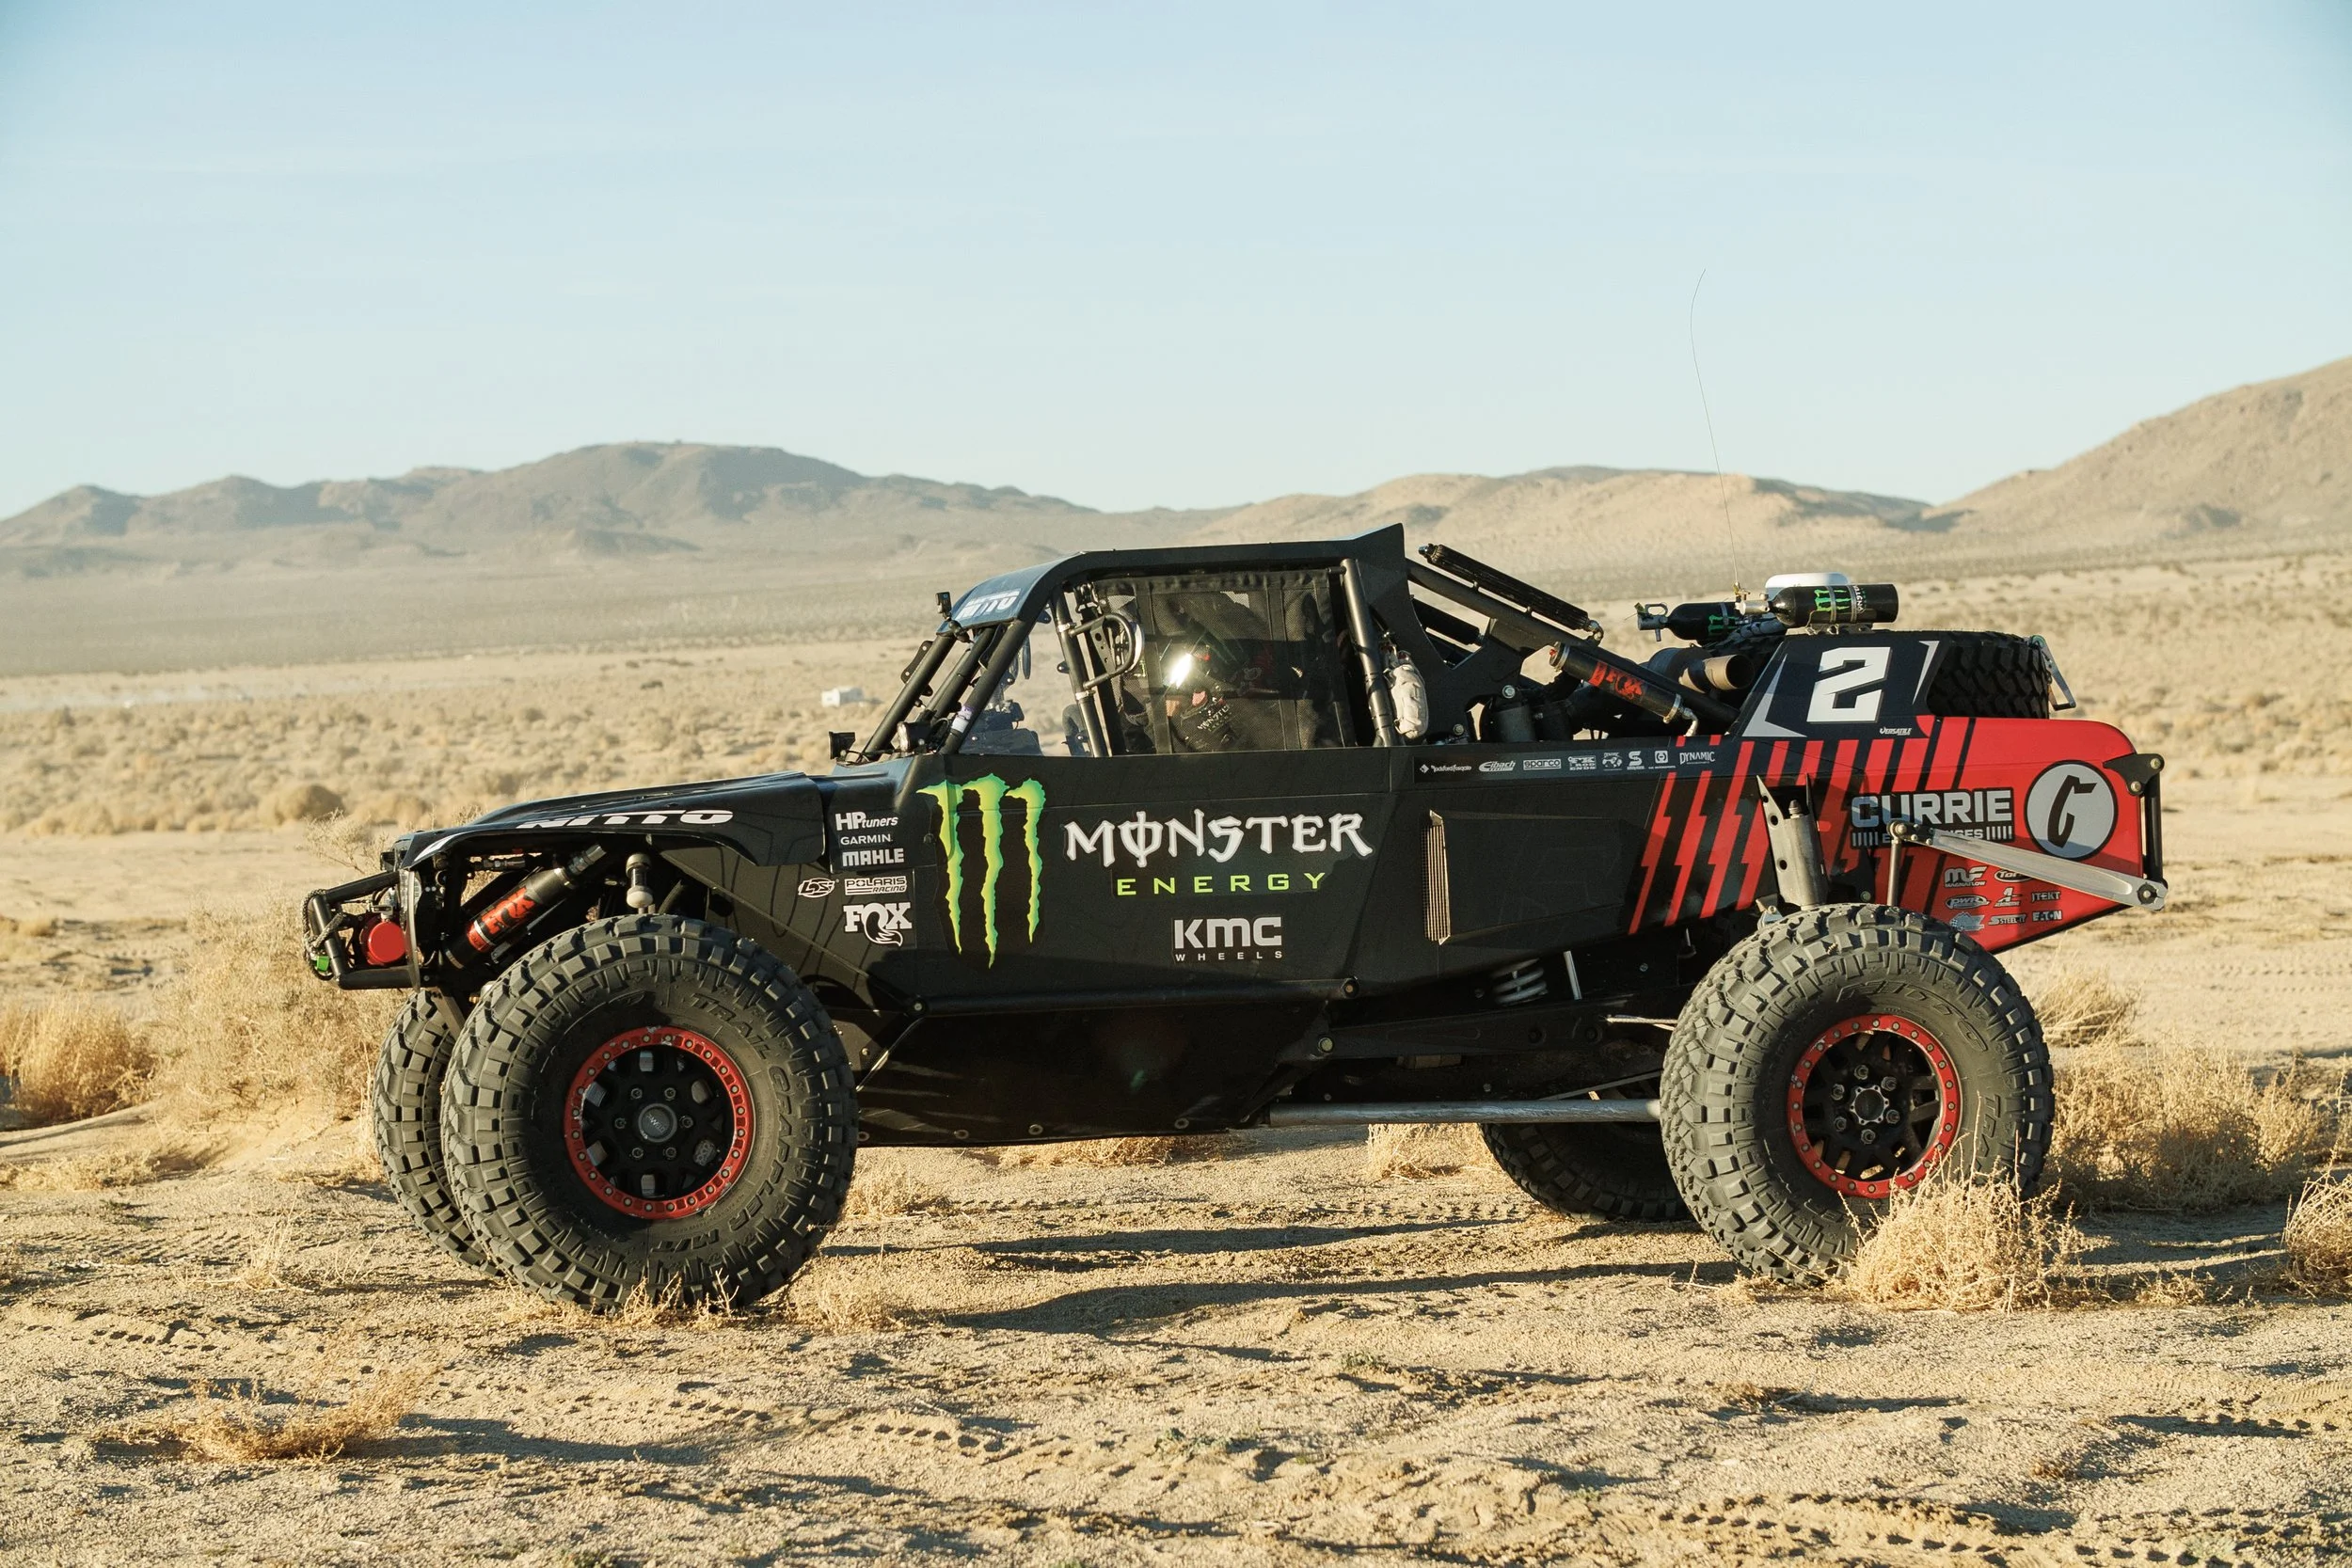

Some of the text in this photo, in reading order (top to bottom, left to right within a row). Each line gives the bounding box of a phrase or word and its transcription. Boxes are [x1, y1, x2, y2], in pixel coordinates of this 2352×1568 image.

[1806, 646, 1891, 723] 2
[1524, 759, 1561, 768] sparco
[1679, 752, 1716, 765] DYNAMIC
[1851, 789, 2012, 829] CURRIE
[516, 809, 734, 830] NITTO
[840, 833, 892, 846] GARMIN
[1064, 809, 1374, 868] MONSTER
[842, 847, 905, 867] MAHLE
[846, 877, 906, 888] POLARIS
[872, 885, 906, 894] RACING
[1117, 871, 1326, 896] ENERGY
[2031, 891, 2060, 902] JTEKT
[843, 902, 913, 946] FOX
[1173, 916, 1282, 950] KMC
[1175, 950, 1283, 962] WHEELS
